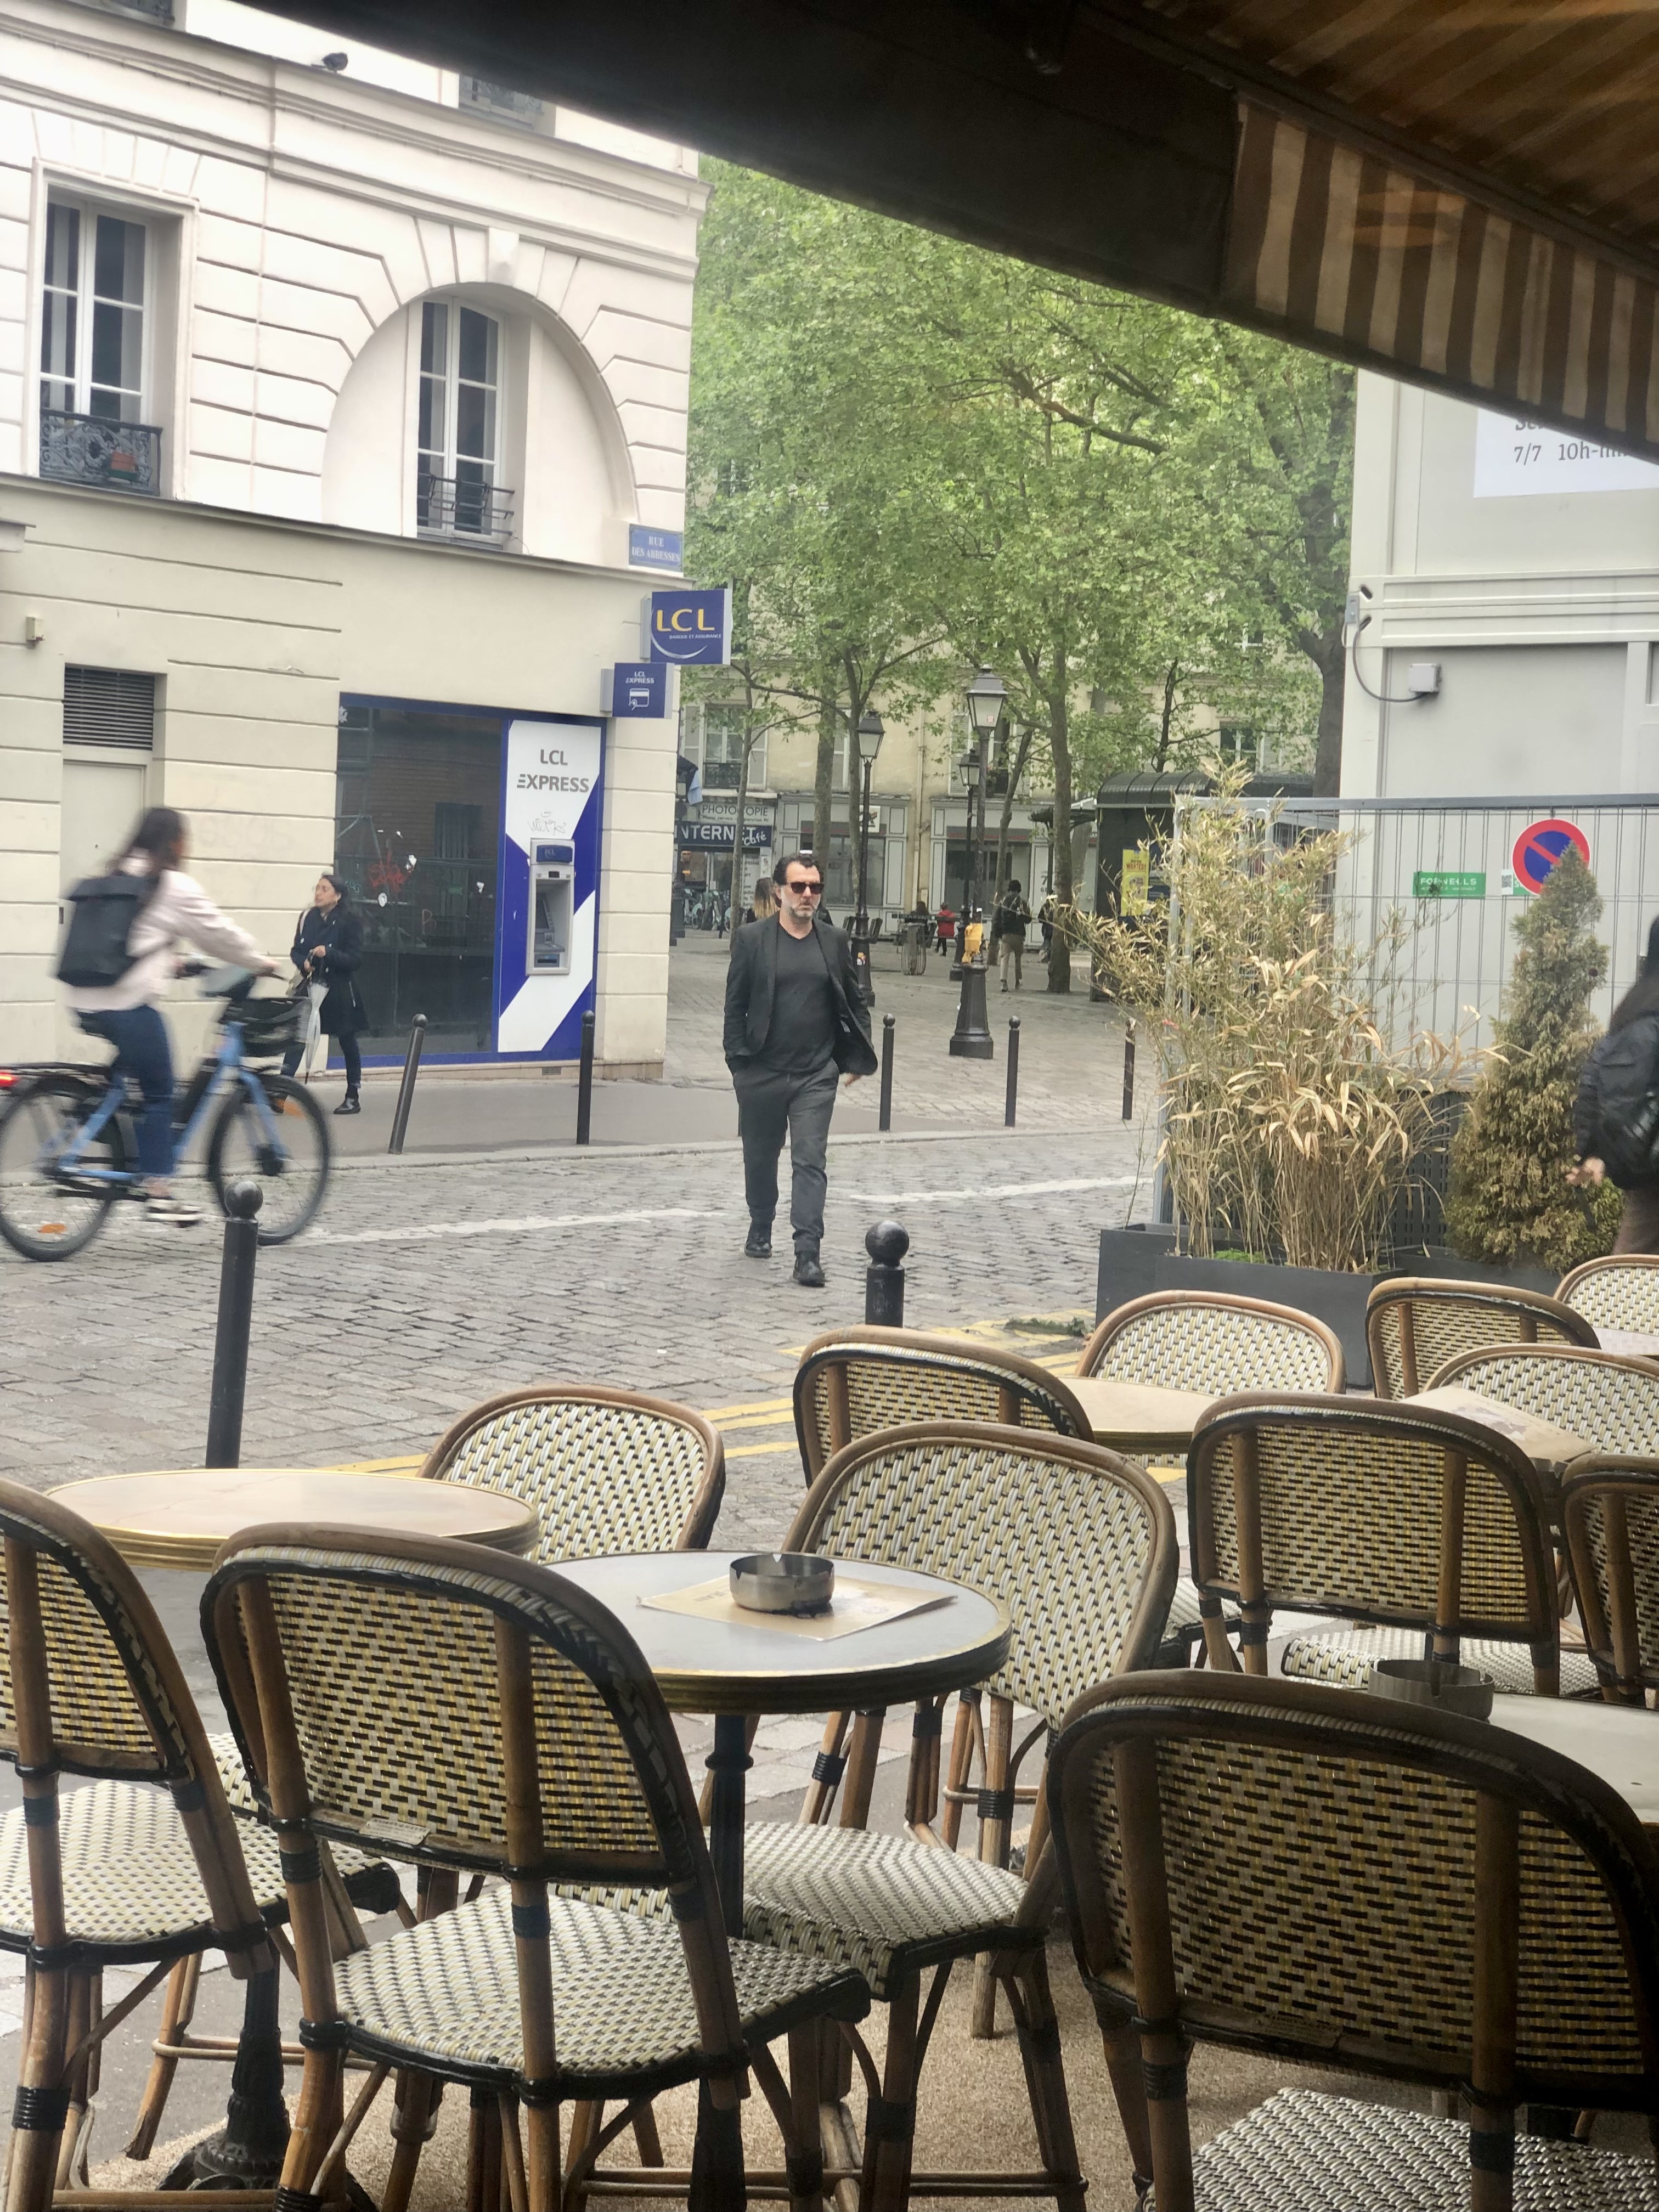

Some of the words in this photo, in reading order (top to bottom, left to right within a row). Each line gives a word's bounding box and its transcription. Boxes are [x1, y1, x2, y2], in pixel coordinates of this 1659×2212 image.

[1514, 443, 1542, 465] 7/7
[649, 536, 664, 547] RUE
[632, 546, 645, 557] DES
[646, 549, 680, 562] ABBESSES
[657, 608, 715, 631] LCL
[540, 749, 568, 765] LCL
[517, 774, 589, 792] EXPRESS
[703, 804, 768, 816] PHOTOOPIE
